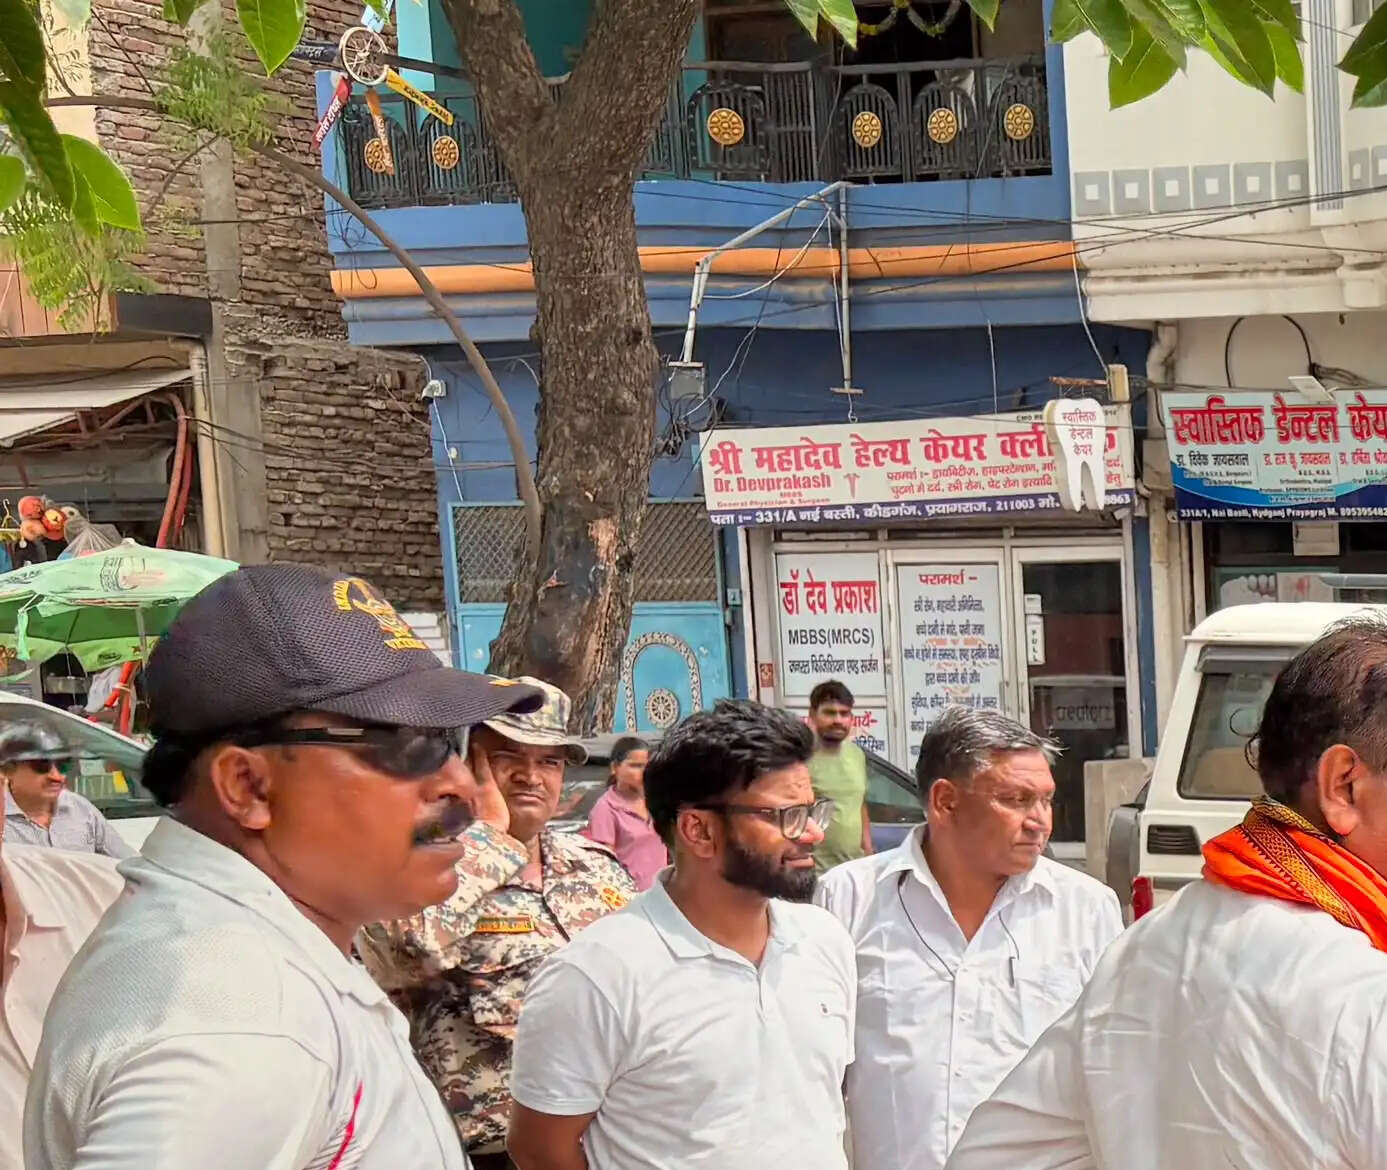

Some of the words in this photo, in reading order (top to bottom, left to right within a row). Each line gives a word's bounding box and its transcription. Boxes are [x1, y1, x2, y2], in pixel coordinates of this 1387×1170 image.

[1169, 395, 1265, 445] स्वास्तिक
[1272, 392, 1341, 444] डेन्टल
[709, 441, 743, 475] श्री
[751, 436, 842, 473] महादेव
[920, 428, 988, 464] केयर
[1073, 442, 1093, 456] केयर
[713, 476, 734, 493] Dr.
[736, 472, 832, 493] Devprakash
[710, 511, 735, 525] पता
[756, 509, 798, 523] 331/A
[996, 498, 1035, 512] 211003
[918, 568, 965, 585] परामर्श
[780, 568, 799, 615] डॉ
[803, 568, 827, 615] देव
[831, 579, 878, 614] प्रकाश
[788, 628, 875, 649] MBBS(MRCS)
